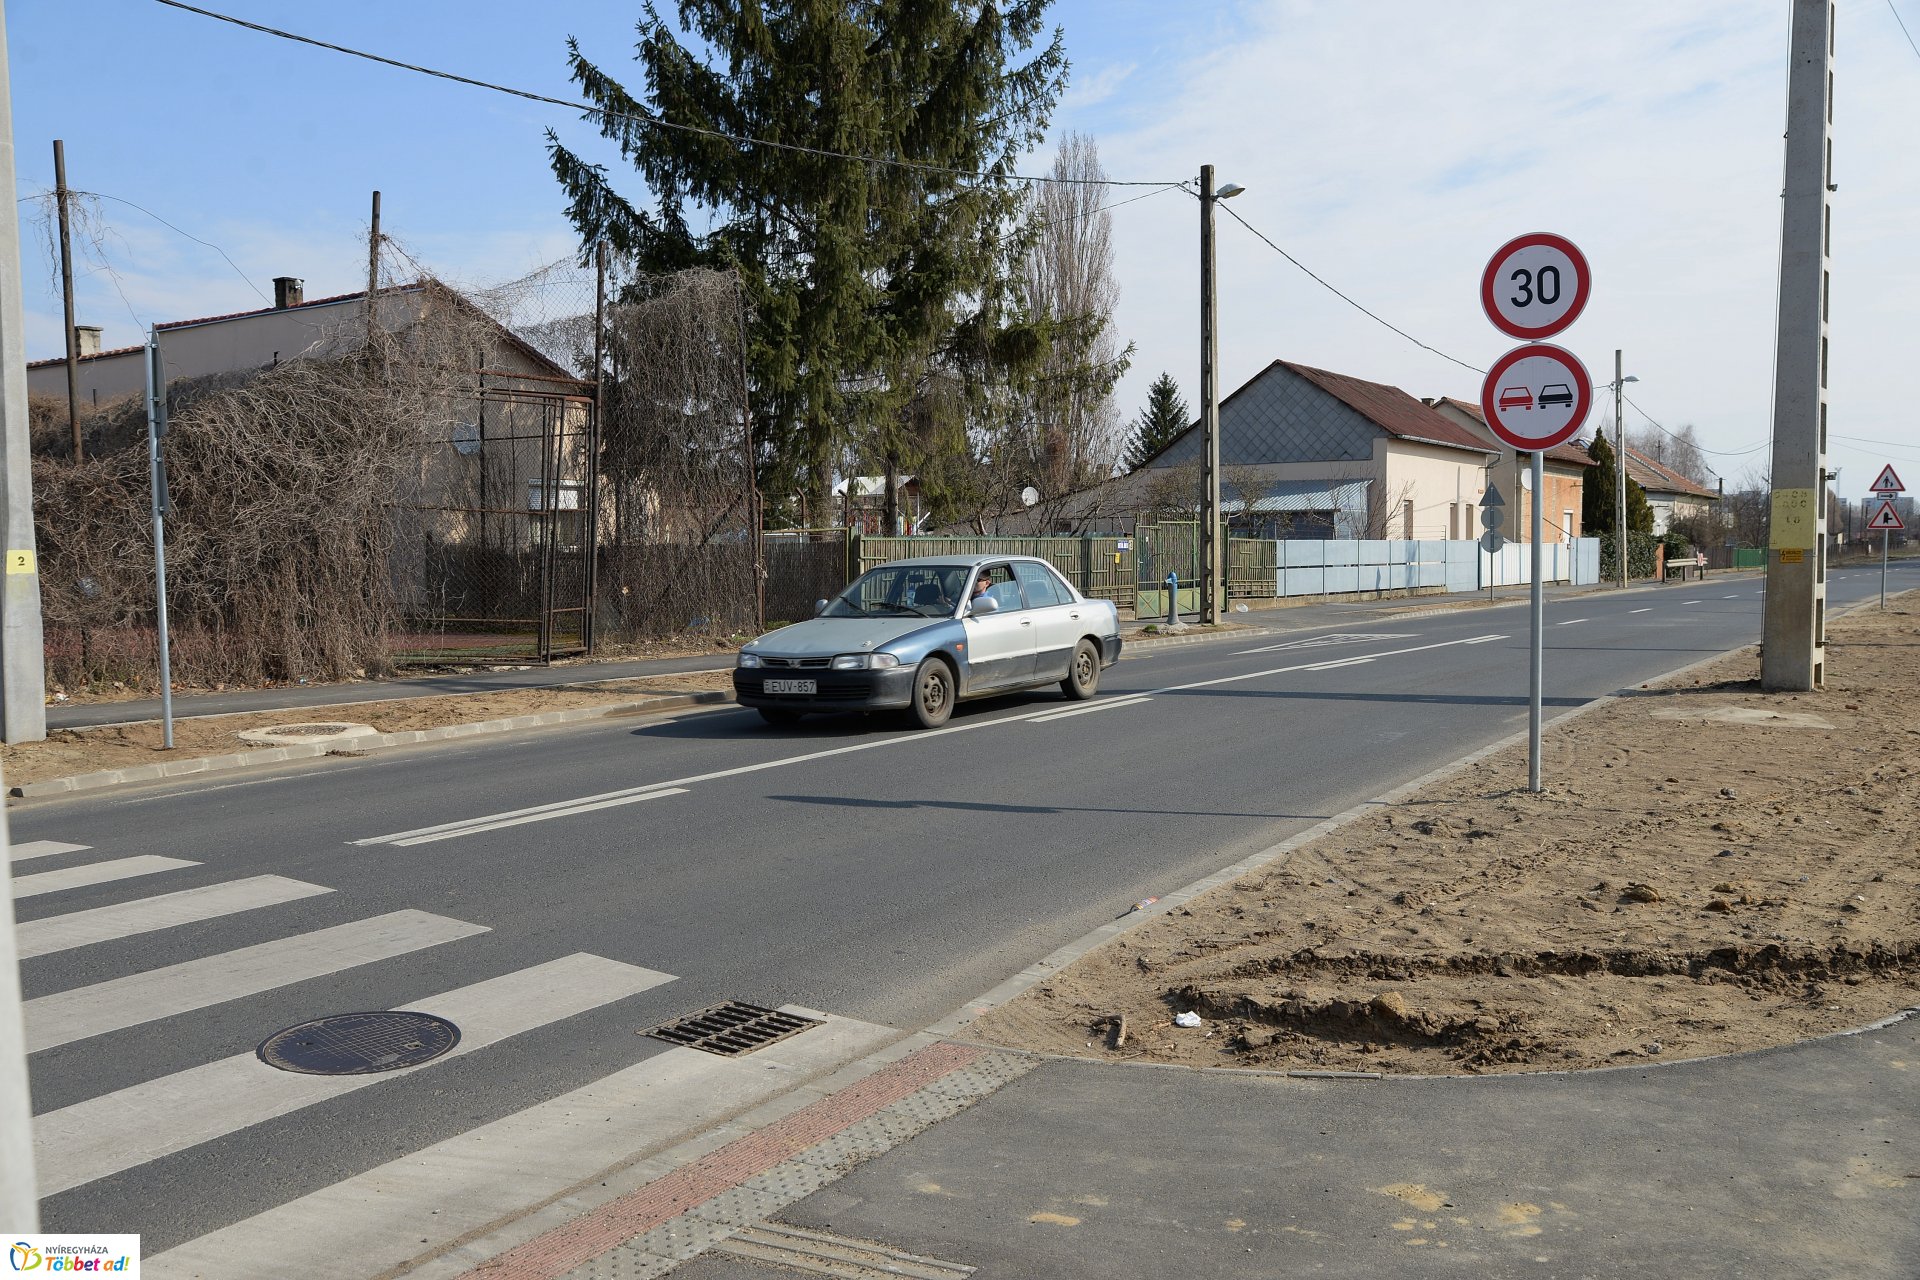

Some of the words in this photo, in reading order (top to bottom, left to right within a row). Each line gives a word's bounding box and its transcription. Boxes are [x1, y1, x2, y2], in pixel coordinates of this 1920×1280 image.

[1510, 265, 1560, 308] 30
[17, 556, 25, 566] 2
[772, 681, 815, 693] EUV-857
